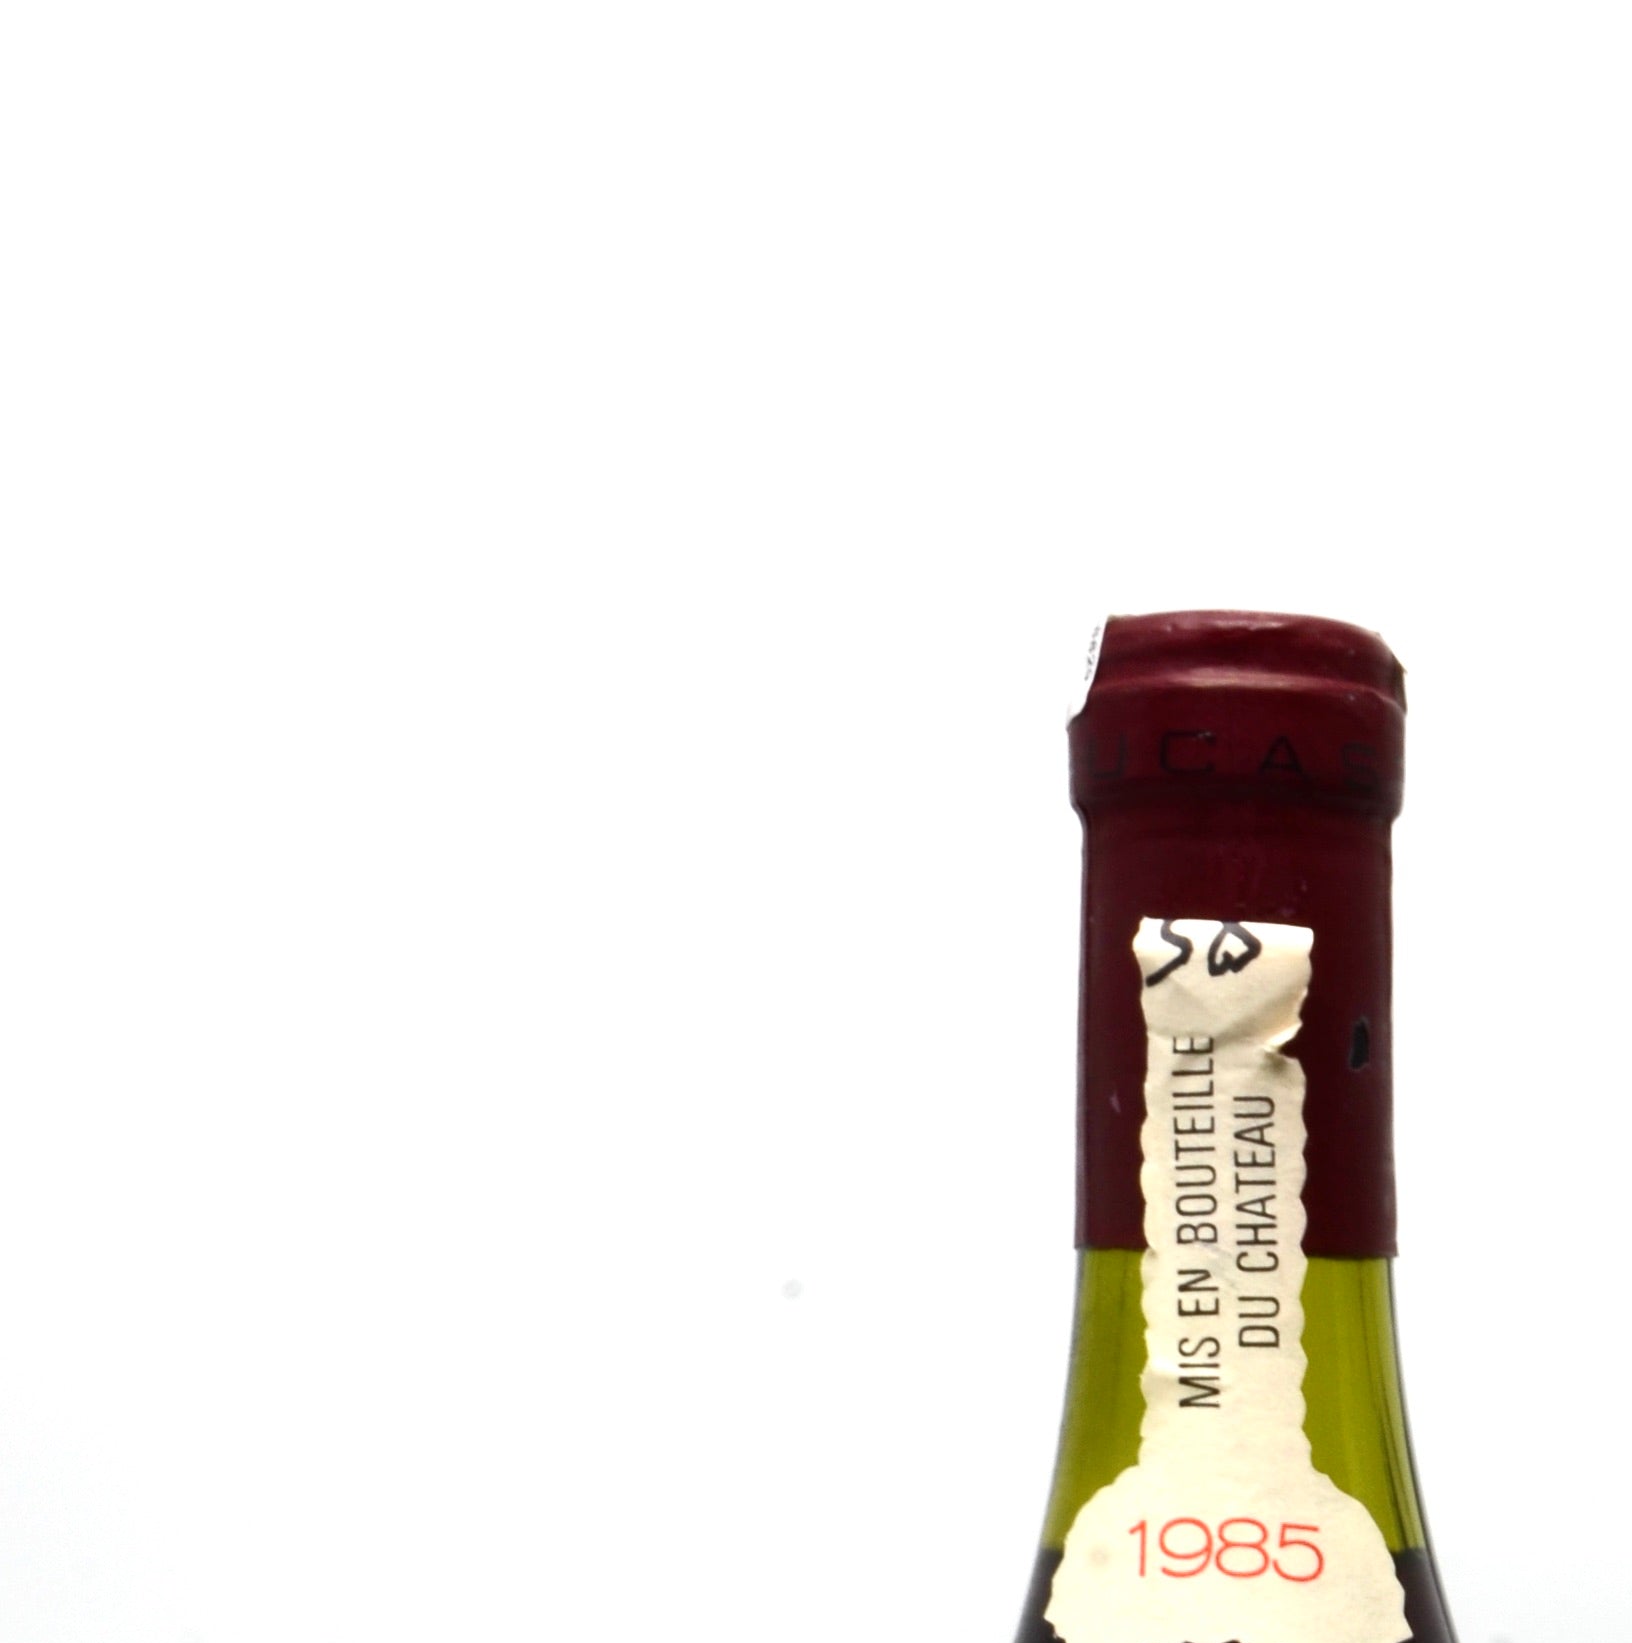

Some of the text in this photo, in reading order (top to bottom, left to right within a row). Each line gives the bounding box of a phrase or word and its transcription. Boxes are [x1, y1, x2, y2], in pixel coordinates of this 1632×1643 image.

[1172, 1035, 1222, 1409] MIS EN BOUTEILLE
[1234, 1094, 1280, 1348] DU CHATEAU
[1128, 1516, 1326, 1583] 1985
